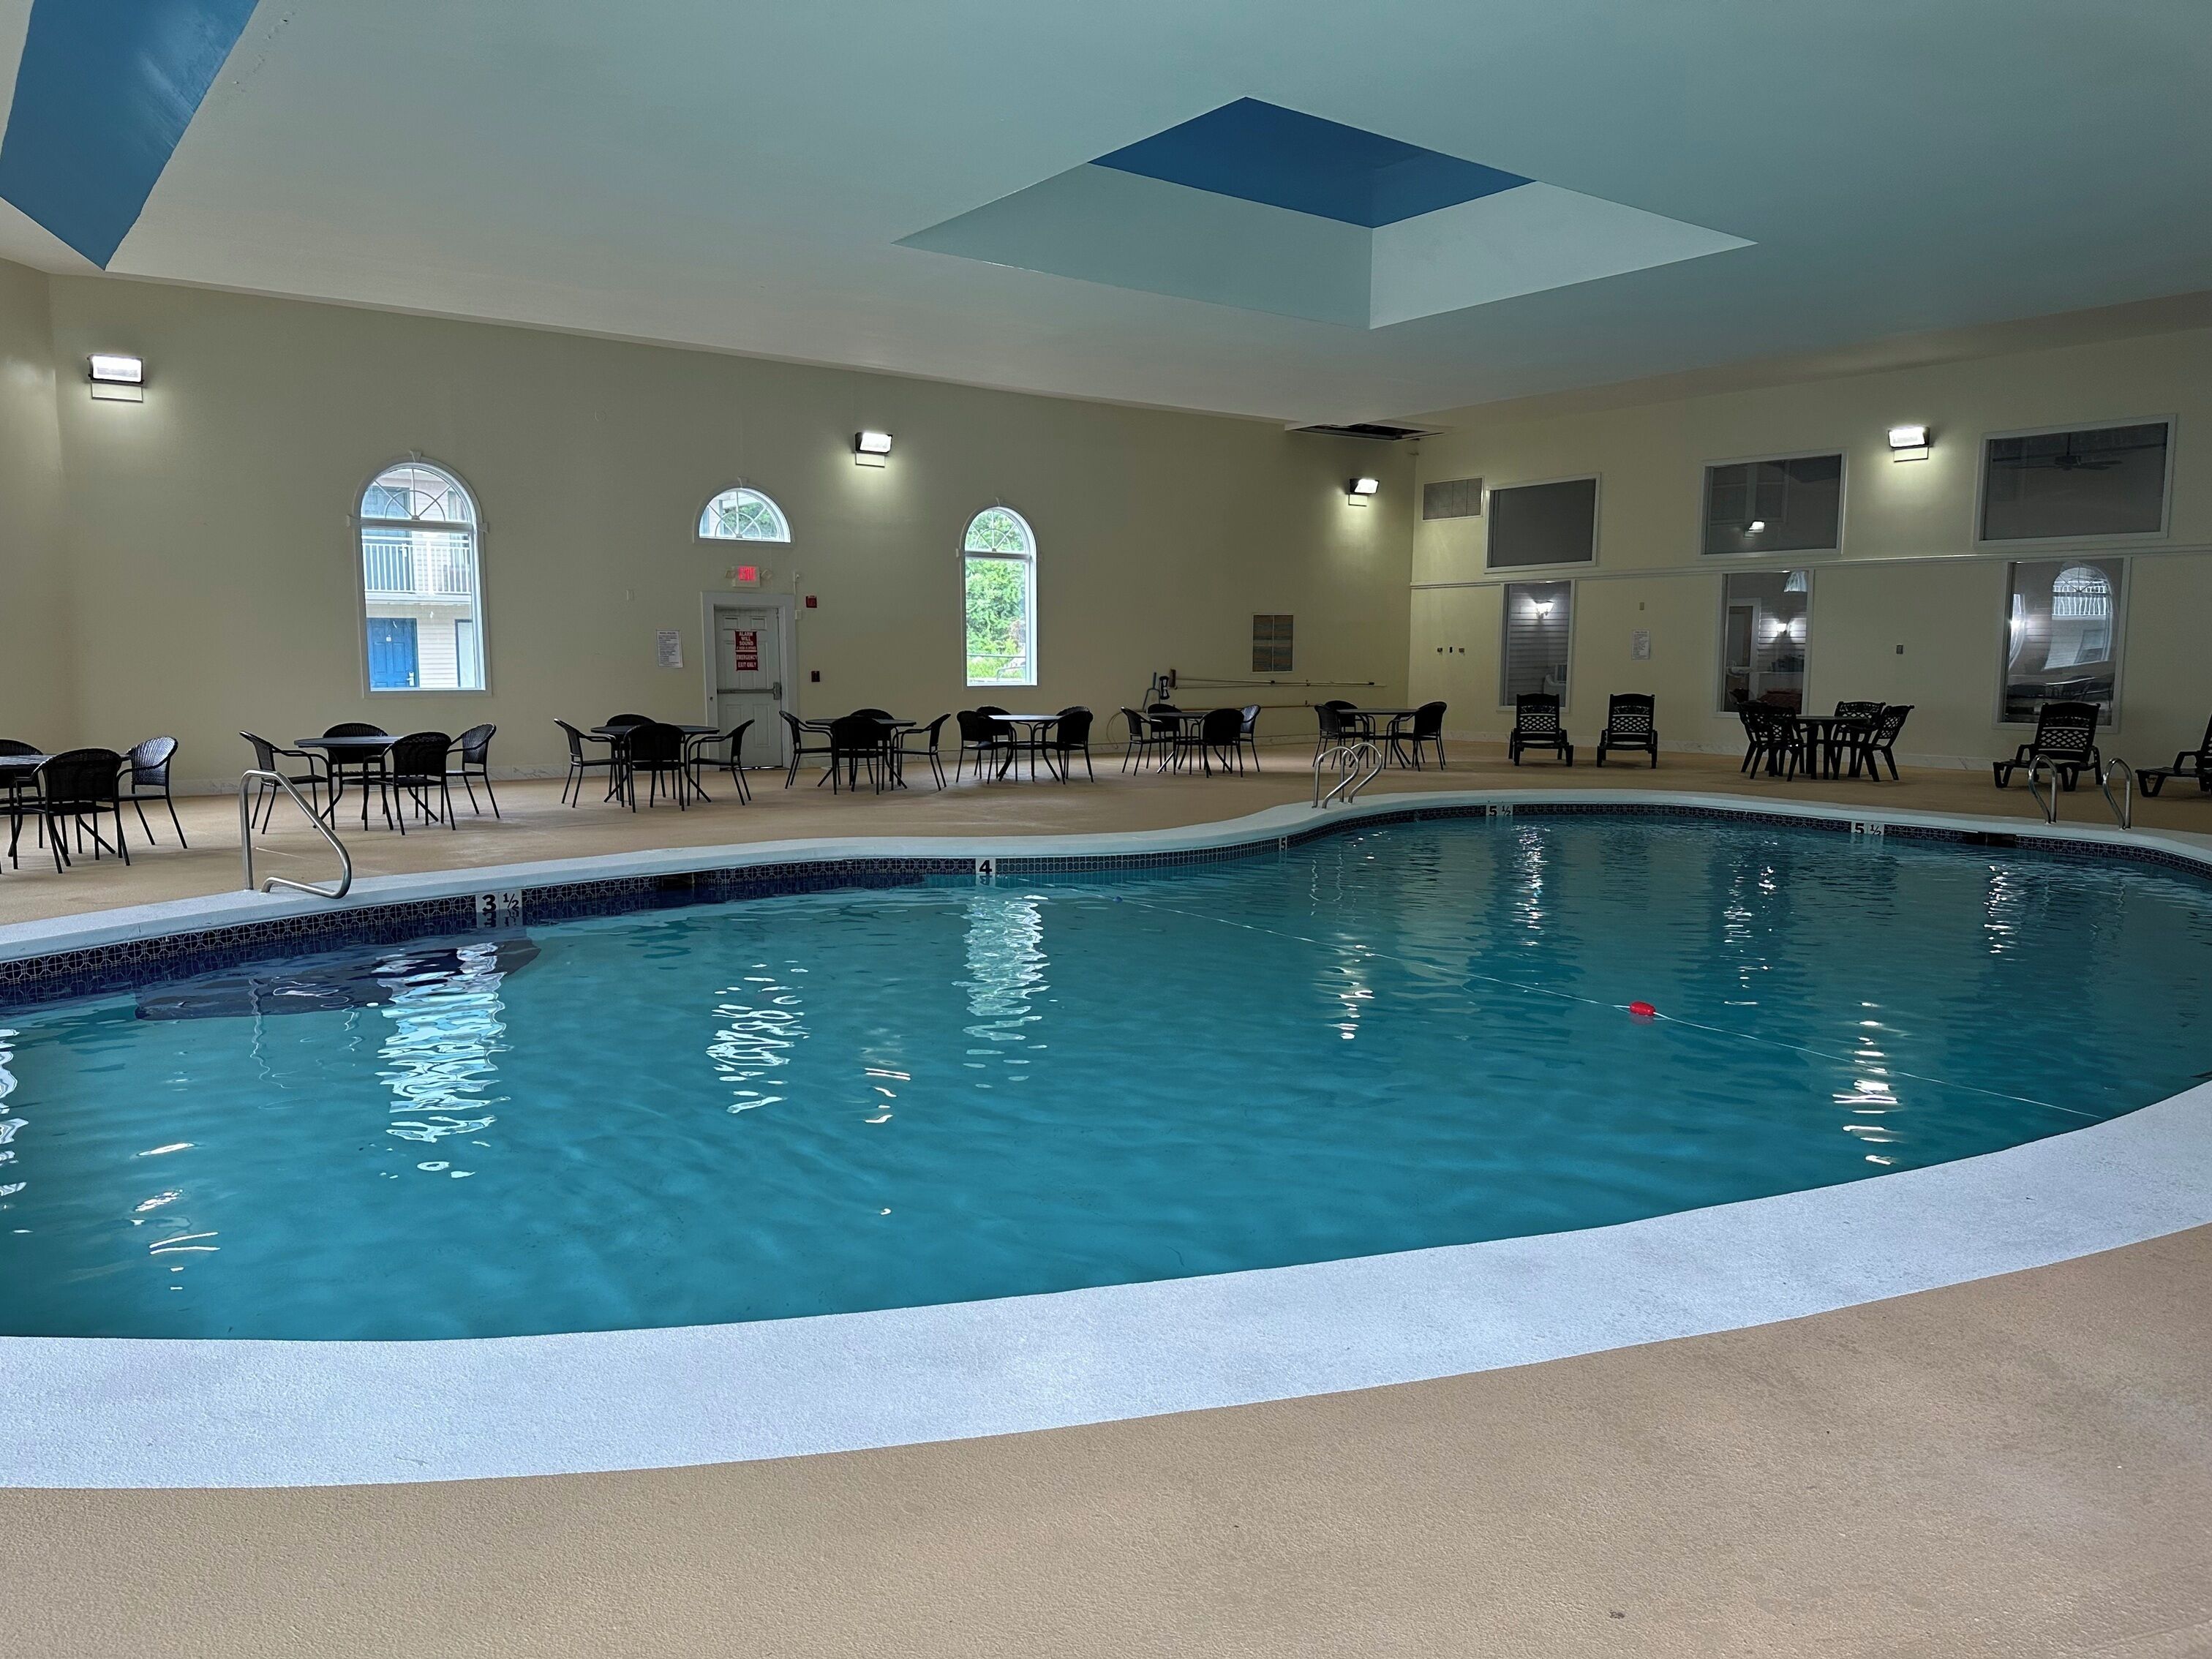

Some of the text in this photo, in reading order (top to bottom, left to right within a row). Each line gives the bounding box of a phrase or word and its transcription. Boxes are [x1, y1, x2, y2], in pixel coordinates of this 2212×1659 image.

[1489, 805, 1497, 816] 5
[1854, 822, 1865, 834] 5
[1280, 838, 1286, 850] 5
[979, 859, 993, 875] 4
[482, 894, 497, 913] 3
